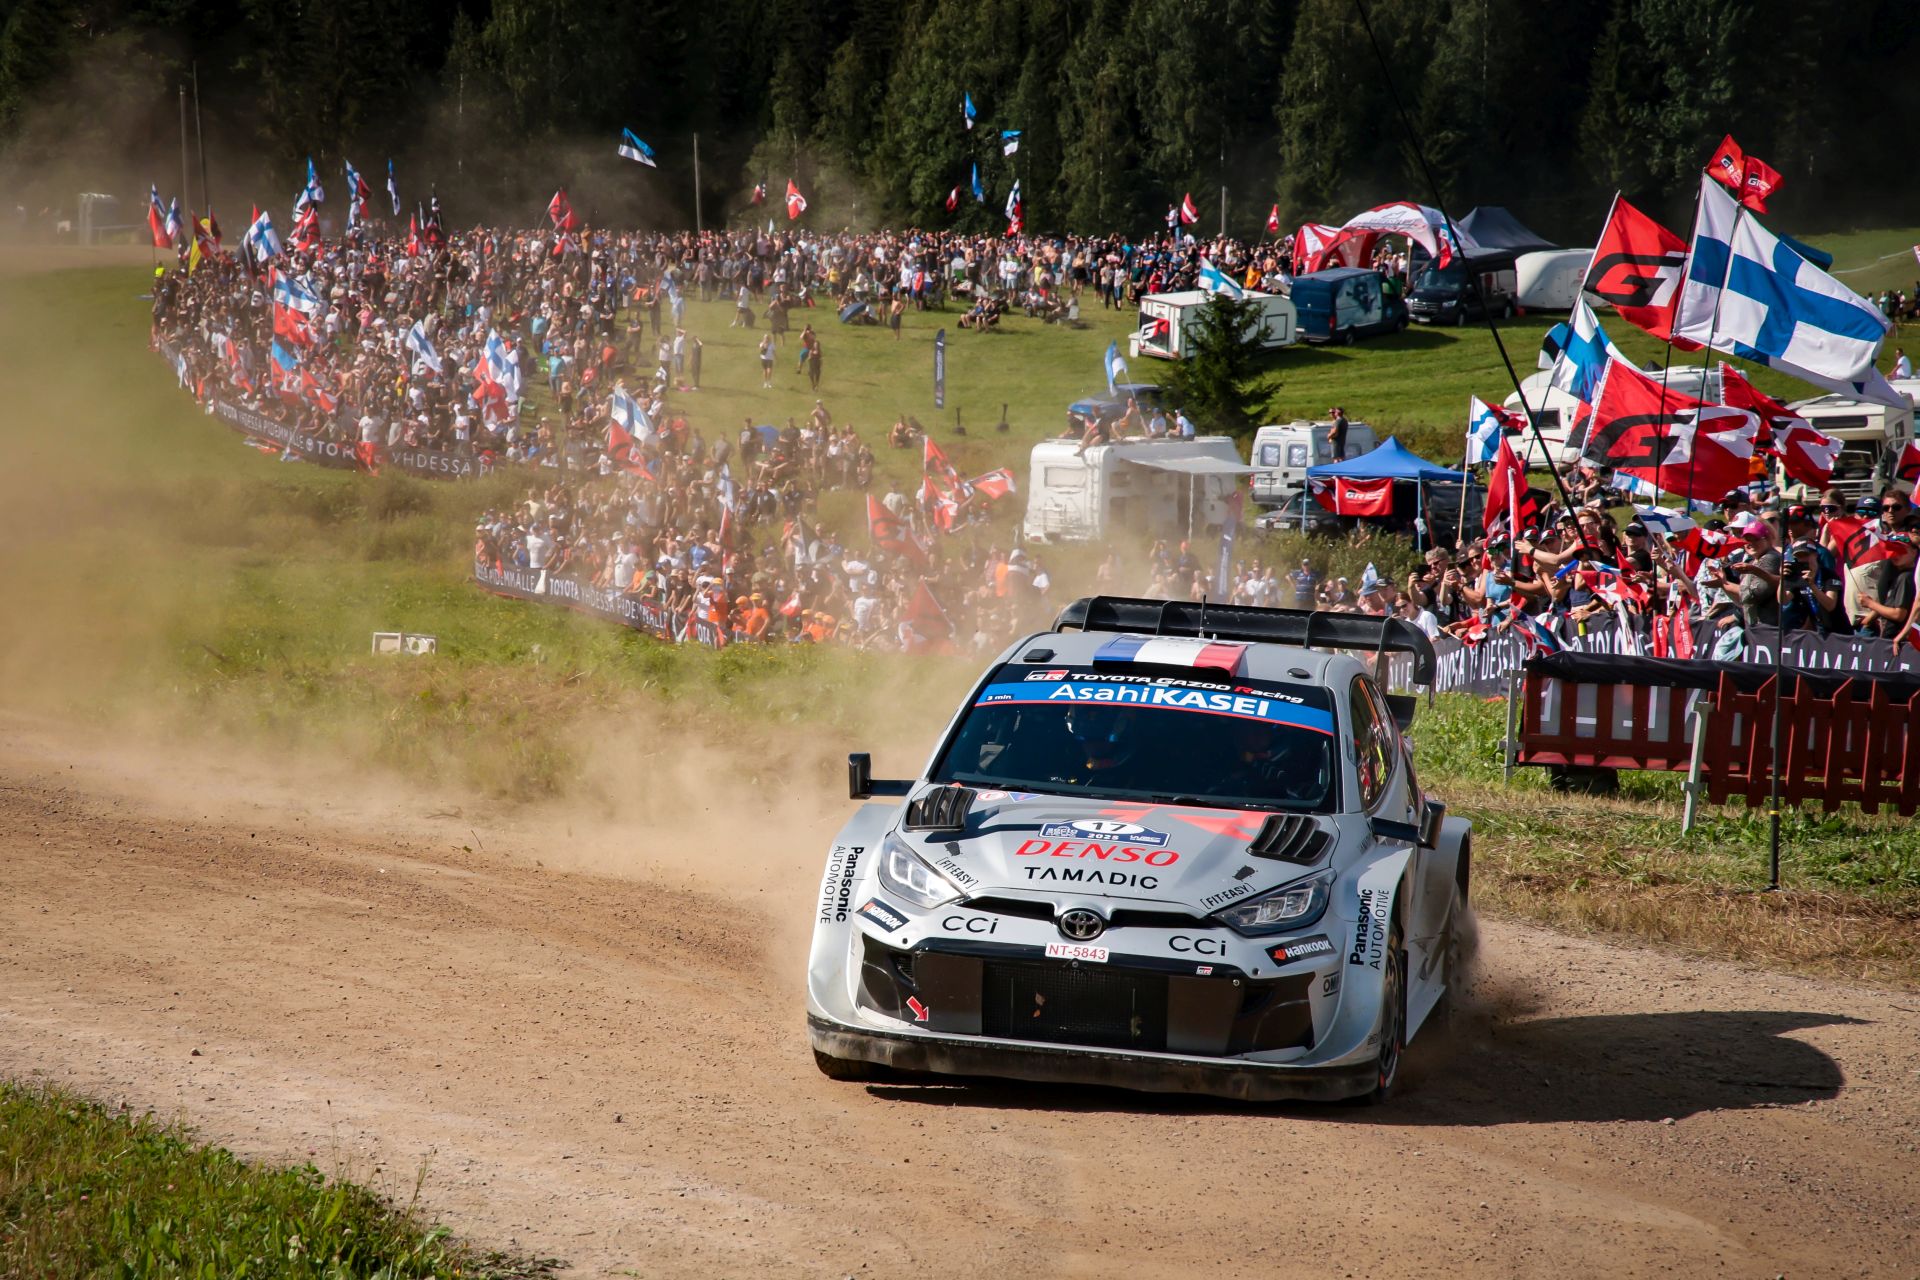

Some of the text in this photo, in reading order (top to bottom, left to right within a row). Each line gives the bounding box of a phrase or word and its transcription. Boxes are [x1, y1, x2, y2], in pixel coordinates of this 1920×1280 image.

[550, 578, 579, 600] TOYOTA
[1435, 646, 1465, 693] OYOTA
[1071, 673, 1152, 683] TOYOTA
[1234, 686, 1304, 704] Racing
[1087, 832, 1119, 841] 2025
[1092, 822, 1127, 832] 17
[1015, 839, 1179, 867] DENSO
[820, 845, 846, 925] AUTOMOTIVE
[835, 846, 865, 923] Panasonic
[1024, 866, 1159, 890] TAMADIC
[942, 915, 999, 936] CCi
[1349, 888, 1373, 966] Panasonic
[1369, 889, 1390, 970] AUTOMOTIVE
[1048, 944, 1107, 960] NT-5843
[1168, 935, 1226, 957] CCi
